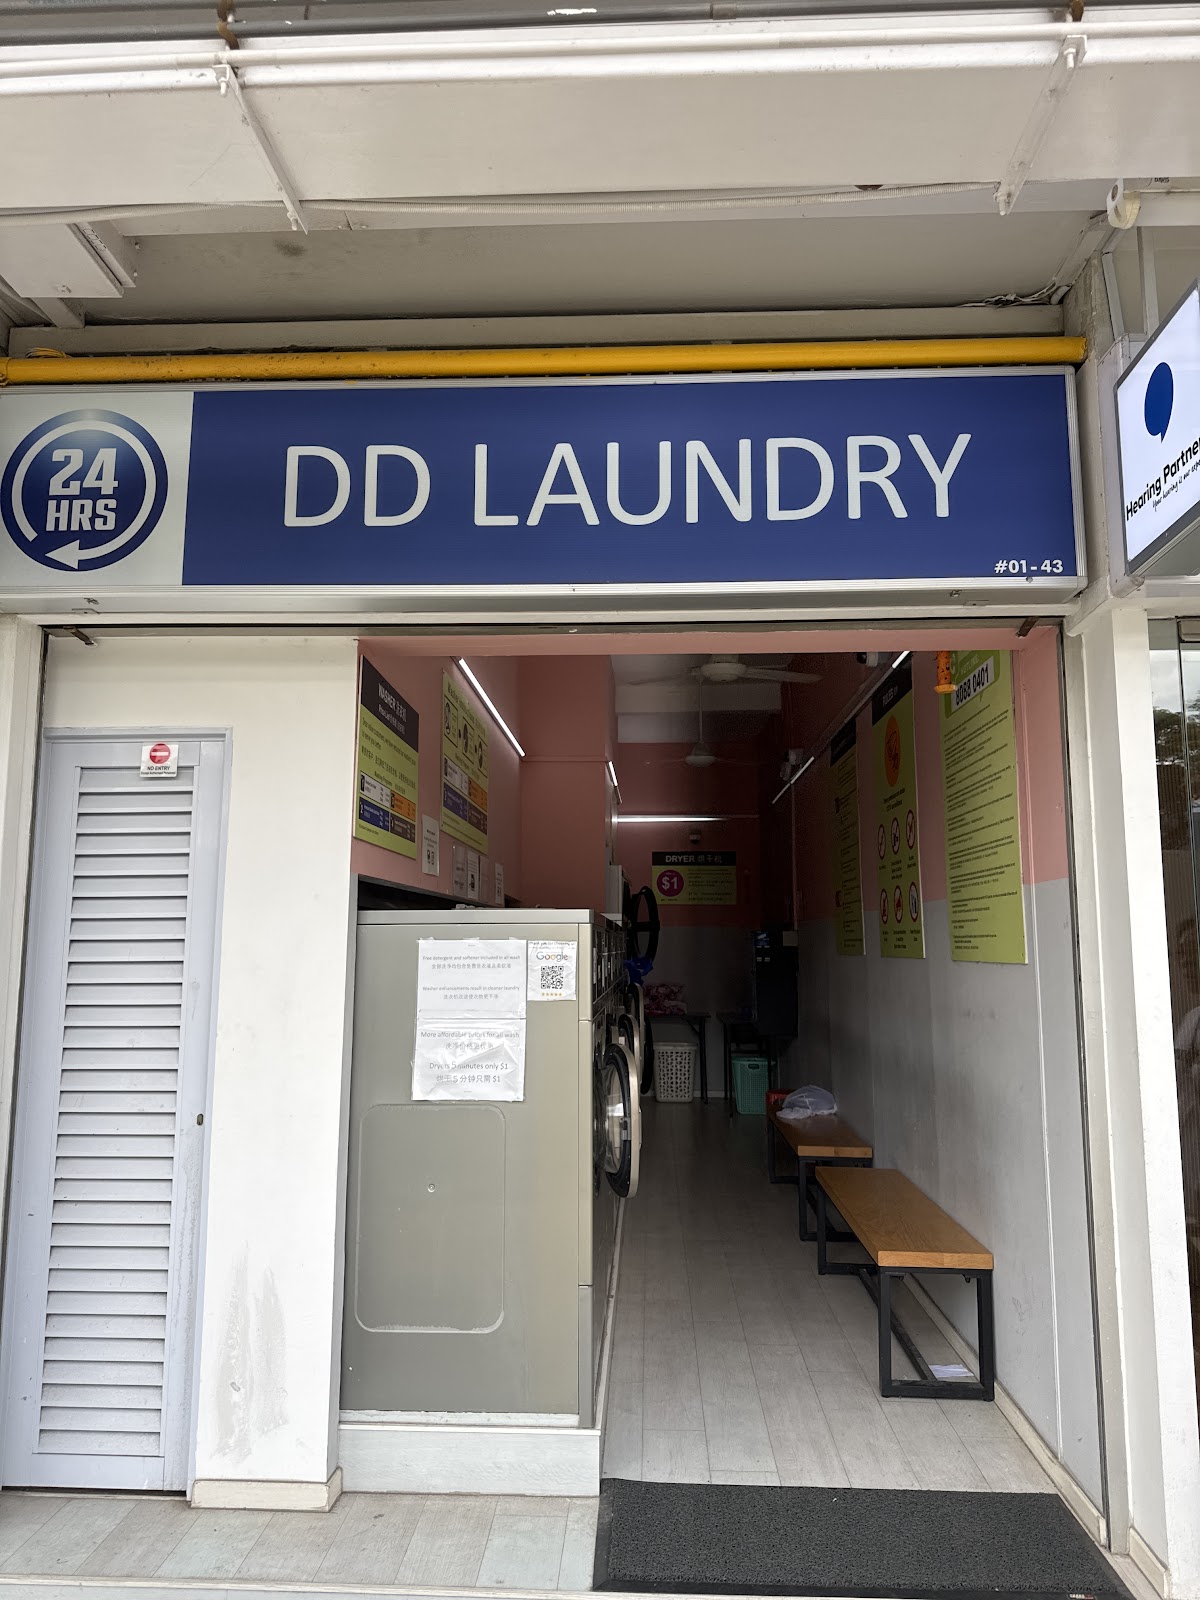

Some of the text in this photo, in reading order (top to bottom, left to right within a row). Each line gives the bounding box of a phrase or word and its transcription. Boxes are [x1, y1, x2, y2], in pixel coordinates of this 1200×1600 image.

[49, 448, 118, 496] 24
[285, 433, 972, 527] DD LAUNDRY
[1126, 476, 1162, 521] Hearing
[46, 499, 117, 531] HRS
[972, 663, 989, 693] 0401
[665, 855, 696, 863] DRYER
[661, 876, 678, 890] $1
[536, 951, 568, 962] Google
[468, 1031, 485, 1039] prices
[452, 1061, 457, 1069] 5
[500, 1062, 508, 1070] $1
